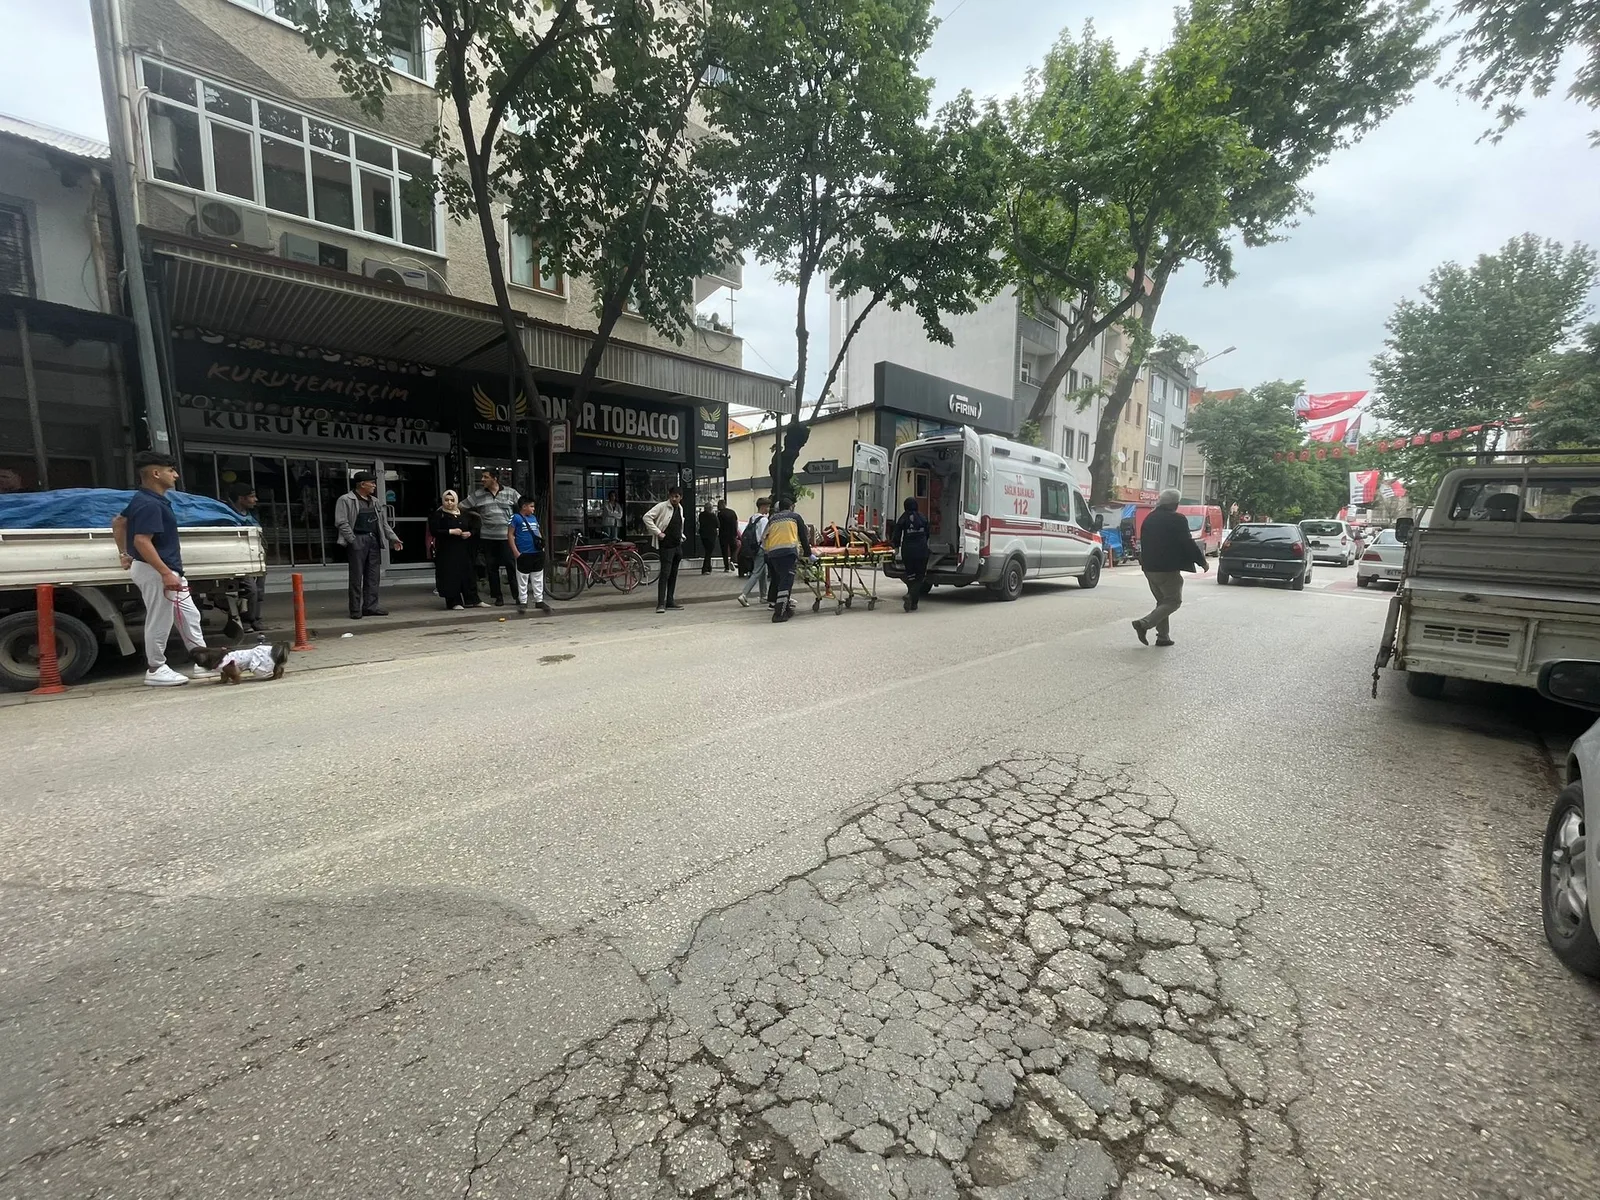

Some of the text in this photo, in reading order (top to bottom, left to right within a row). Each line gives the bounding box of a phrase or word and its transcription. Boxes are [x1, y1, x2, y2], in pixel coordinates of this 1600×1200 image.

[207, 361, 410, 404] KURUYEMİŞÇİM
[955, 402, 977, 417] FIRINI
[539, 394, 680, 442] ONR TOBACCO
[704, 422, 716, 430] ONUR
[701, 429, 719, 438] TOBACCO
[1013, 498, 1029, 515] 112
